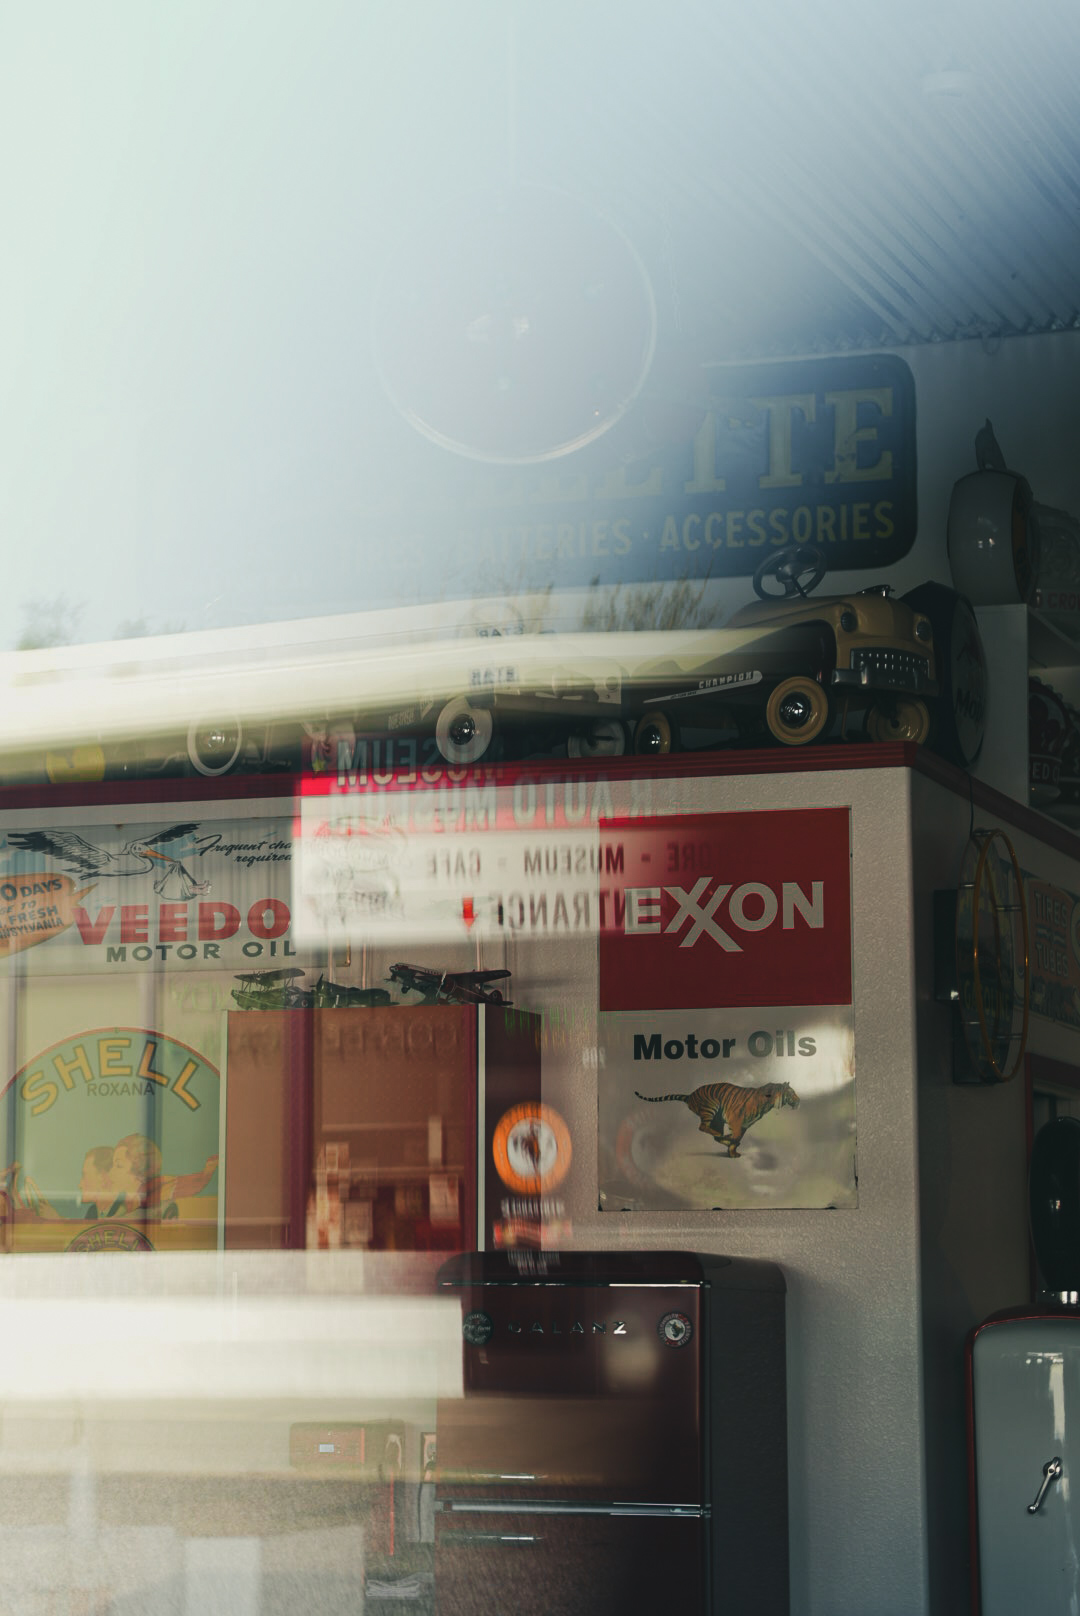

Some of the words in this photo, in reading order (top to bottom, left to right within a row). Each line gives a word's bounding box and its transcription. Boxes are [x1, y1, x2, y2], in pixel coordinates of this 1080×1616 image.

[659, 501, 895, 552] ACCESSORIES
[195, 834, 268, 856] Frequent
[269, 840, 292, 850] cha
[20, 878, 62, 898] DAYS
[71, 898, 291, 946] VEEDO
[624, 876, 825, 953] EXXON
[1034, 891, 1068, 928] TIRES
[106, 943, 221, 962] MOTOR
[242, 940, 297, 958] OIL
[1036, 942, 1069, 977] TUBES
[633, 1033, 736, 1061] Motor
[747, 1030, 817, 1058] Oils
[20, 1037, 202, 1118] SHELL
[87, 1082, 156, 1097] ROXANA
[508, 1320, 627, 1335] GALANZ
